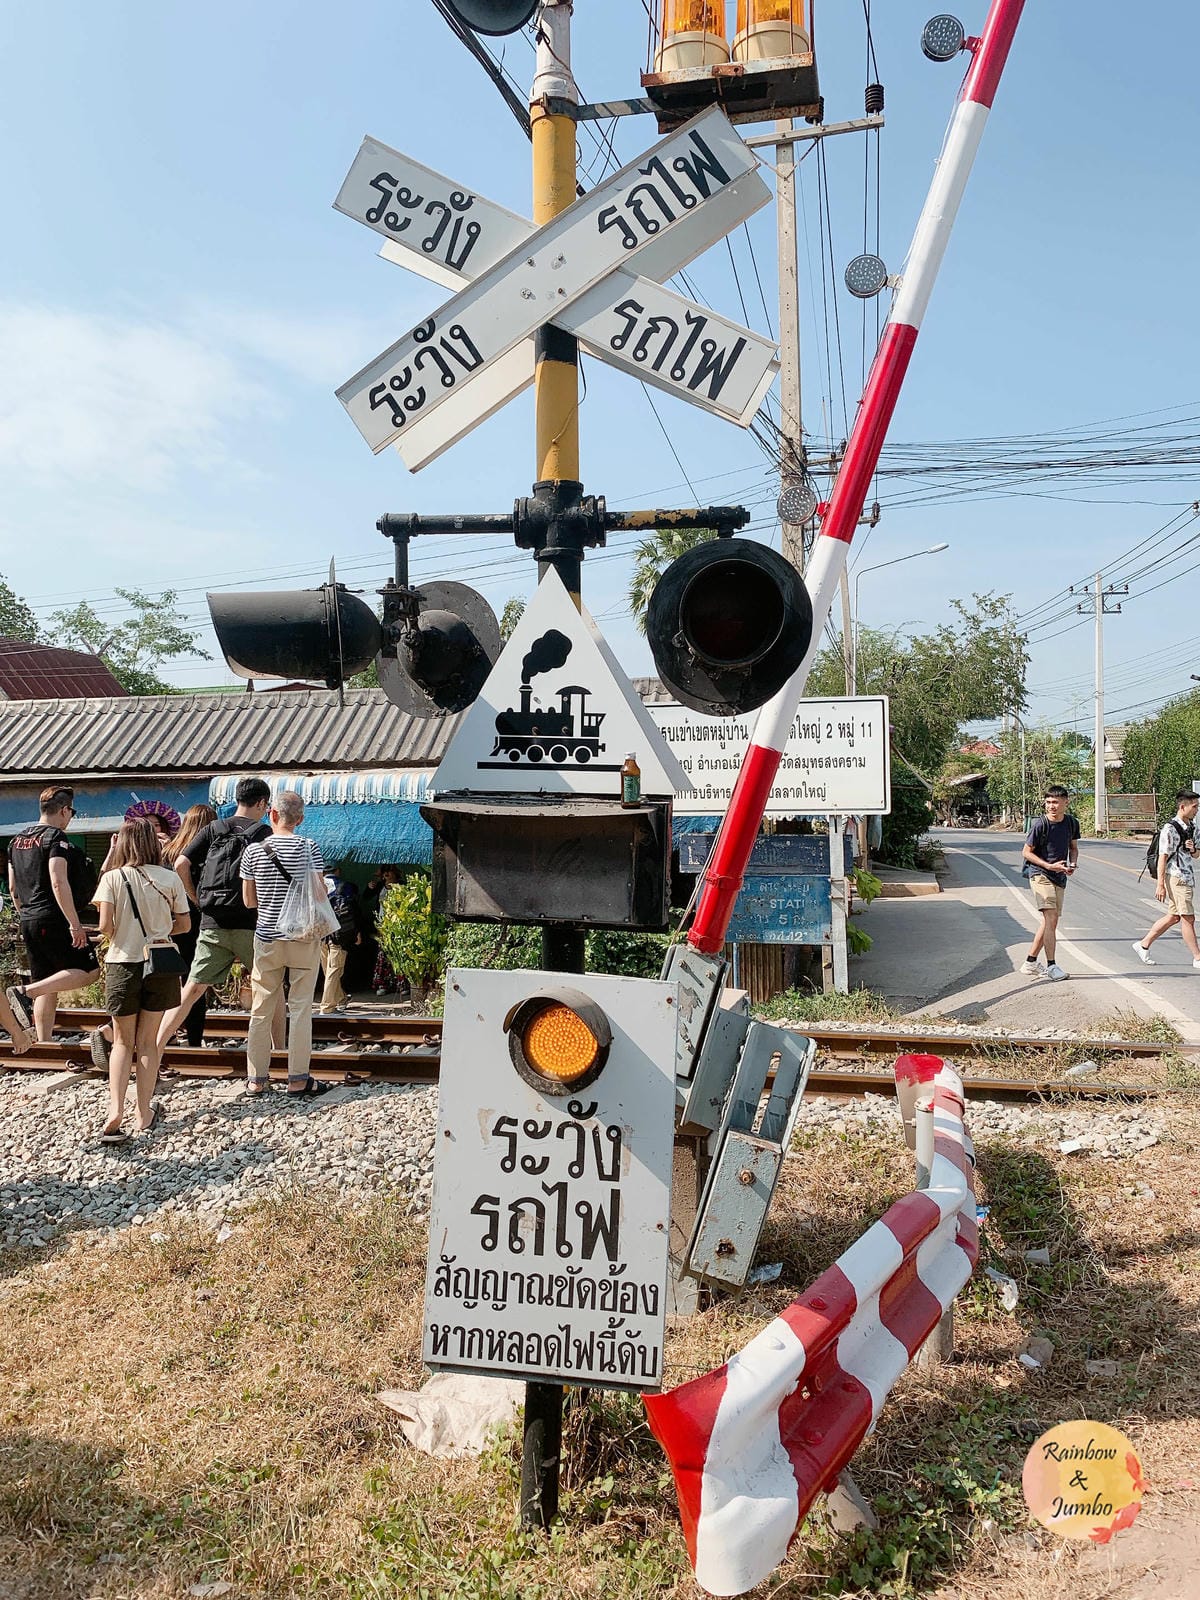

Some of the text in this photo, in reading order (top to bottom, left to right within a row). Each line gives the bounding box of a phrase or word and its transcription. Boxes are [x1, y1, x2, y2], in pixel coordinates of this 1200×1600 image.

[366, 172, 747, 401] ระวัง รถไฟ
[369, 130, 731, 427] ระวัง รถไฟ
[697, 753, 744, 770] อำเภอเมื
[778, 752, 866, 775] วัดสมุทรสงคราม
[826, 722, 833, 739] 2
[838, 716, 855, 747] หมู่
[861, 722, 872, 738] 11
[491, 1100, 622, 1182] ระวัง
[471, 1181, 620, 1262] รถไฟ
[433, 1254, 658, 1317] สัญญาณขัดข้อง
[429, 1317, 658, 1378] หากหลอดไฟนี้ดับ
